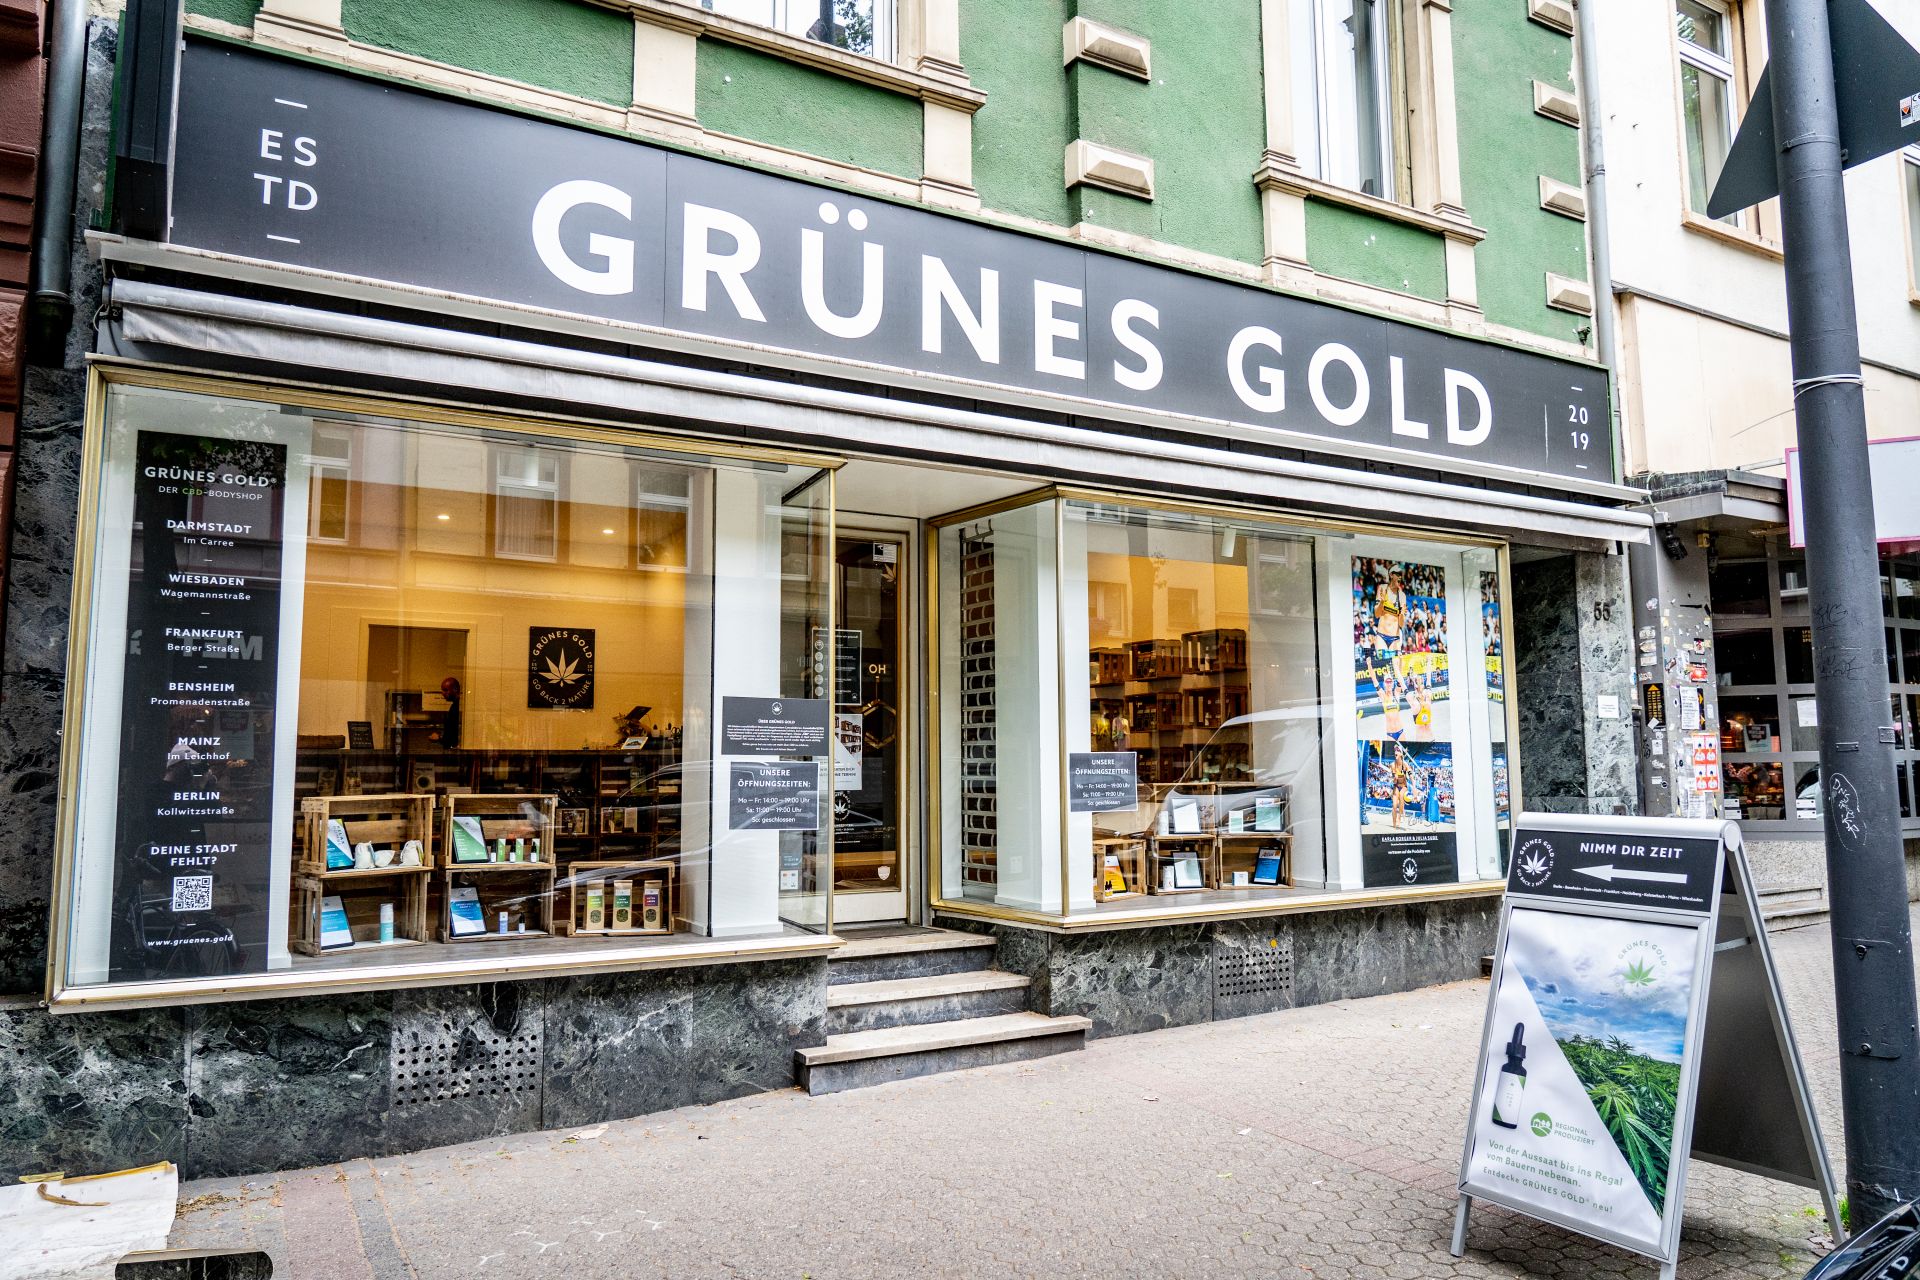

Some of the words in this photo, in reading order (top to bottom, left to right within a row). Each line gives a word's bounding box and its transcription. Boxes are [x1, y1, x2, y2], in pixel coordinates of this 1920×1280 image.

[261, 128, 317, 167] ES
[253, 172, 319, 211] TD
[531, 179, 1164, 391] GRÜNES
[1226, 325, 1493, 446] GOLD
[1568, 404, 1589, 425] 20
[1570, 431, 1589, 451] 19
[144, 465, 216, 483] GRÜNES
[158, 485, 178, 494] DER
[182, 487, 263, 501] CBD-BODYSHOP
[166, 519, 252, 534] DARMSTADT
[183, 536, 196, 545] Im
[200, 538, 234, 547] Carree
[168, 574, 245, 586] WIESBADEN
[160, 588, 251, 600] Wagemannstraße
[165, 628, 244, 639] FRANKFURT
[167, 643, 202, 653] Berger
[206, 644, 240, 653] Straße
[532, 630, 568, 656] GRÜNES
[572, 634, 593, 658] GOLD
[868, 664, 886, 674] OH
[168, 682, 235, 692] BENSHEIM
[532, 679, 541, 690] GO
[540, 690, 558, 704] BACK
[568, 680, 591, 704] NATURE
[150, 697, 250, 707] Promenadenstraße
[178, 737, 220, 746] MAINZ
[168, 752, 180, 760] Im
[184, 752, 230, 760] Leichhof
[738, 779, 811, 788] ÖFFNUNGSZEITEN:
[174, 792, 220, 801] BERLIN
[157, 806, 234, 816] Kollwitzstraße
[150, 846, 190, 855] DEINE
[196, 844, 238, 854] STADT
[1543, 840, 1555, 857] GOLD
[1580, 842, 1616, 855] NIMM
[1621, 846, 1645, 857] DIR
[1650, 847, 1683, 859] ZEIT
[170, 856, 217, 867] FEHLT?
[148, 934, 233, 946] www.gruenes.gold
[1618, 940, 1649, 960] GRÜNES
[1652, 944, 1668, 966] GOLD
[1555, 1122, 1588, 1136] REGIONAL
[1554, 1130, 1595, 1146] PRODUZIERT
[1486, 1152, 1503, 1164] vom
[1506, 1156, 1536, 1174] Bauern
[1538, 1166, 1582, 1188] nebenan.
[1488, 1139, 1504, 1152] Von
[1506, 1143, 1520, 1156] der
[1522, 1146, 1558, 1168] Aussaat
[1560, 1160, 1575, 1173] bis
[1577, 1164, 1592, 1178] ins
[1595, 1170, 1623, 1187] Regal
[1483, 1166, 1520, 1184] Entdecke
[1522, 1178, 1558, 1196] GRÜNES
[1592, 1202, 1614, 1214] neu!
